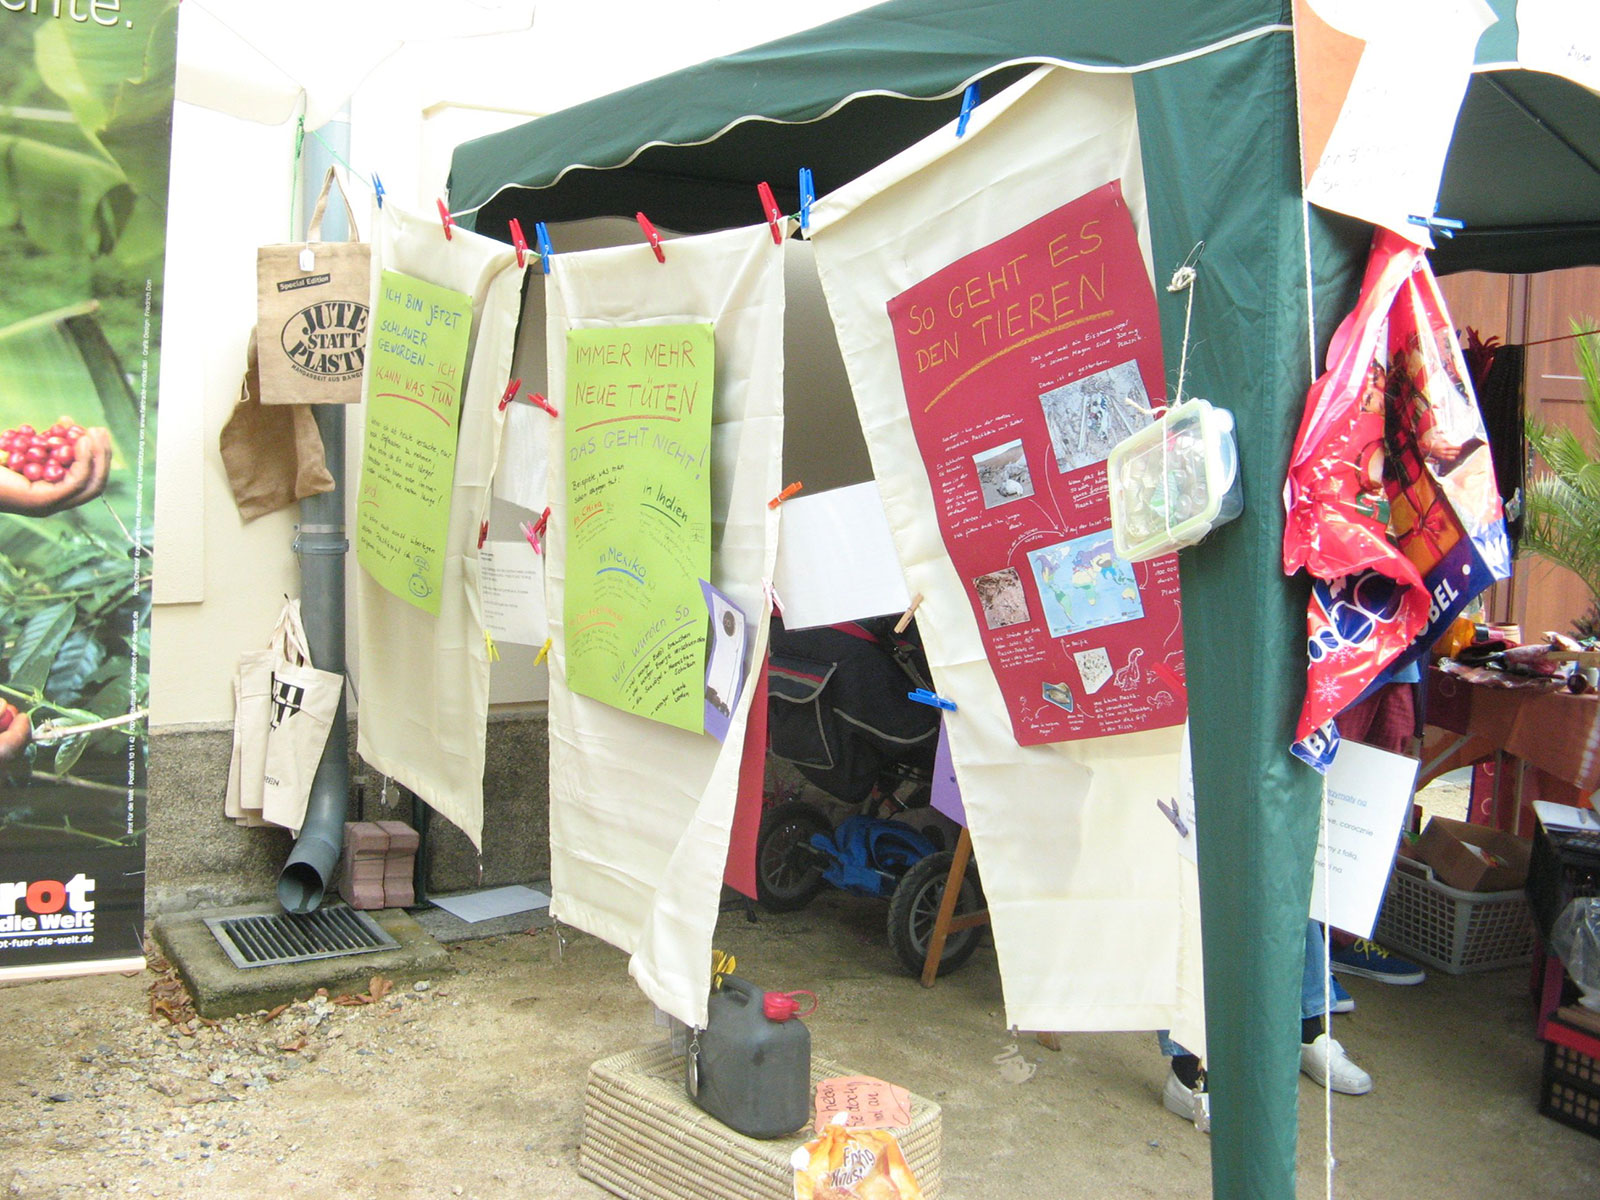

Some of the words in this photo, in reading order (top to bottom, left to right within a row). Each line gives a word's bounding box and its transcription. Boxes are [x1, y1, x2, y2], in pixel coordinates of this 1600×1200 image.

[280, 279, 305, 290] Special
[307, 275, 329, 285] Edition
[908, 305, 935, 336] SO
[948, 254, 1028, 320] GEHT
[1048, 220, 1103, 268] ES
[301, 303, 369, 336] JUTE
[386, 288, 401, 304] ICH
[406, 293, 423, 312] BIN
[426, 304, 462, 329] JETZT
[915, 331, 959, 373] DEN
[972, 262, 1105, 346] TIEREN
[308, 333, 361, 349] STATT
[380, 320, 428, 347] SCHLAUER
[288, 340, 366, 373] PLASTI
[378, 338, 426, 366] GEWORDEN
[438, 361, 456, 380] ICH
[576, 343, 632, 367] IMMER
[645, 340, 696, 368] MEHR
[376, 366, 400, 386] KANN
[405, 379, 425, 398] WAS
[432, 386, 452, 406] TUN
[575, 382, 617, 407] NEUE
[627, 376, 698, 414] TÜTEN
[570, 437, 597, 462] DAS
[603, 427, 649, 448] GEHT
[656, 484, 688, 522] Indien
[608, 546, 647, 578] Mexiko
[0, 915, 37, 932] die
[40, 912, 94, 929] Welt
